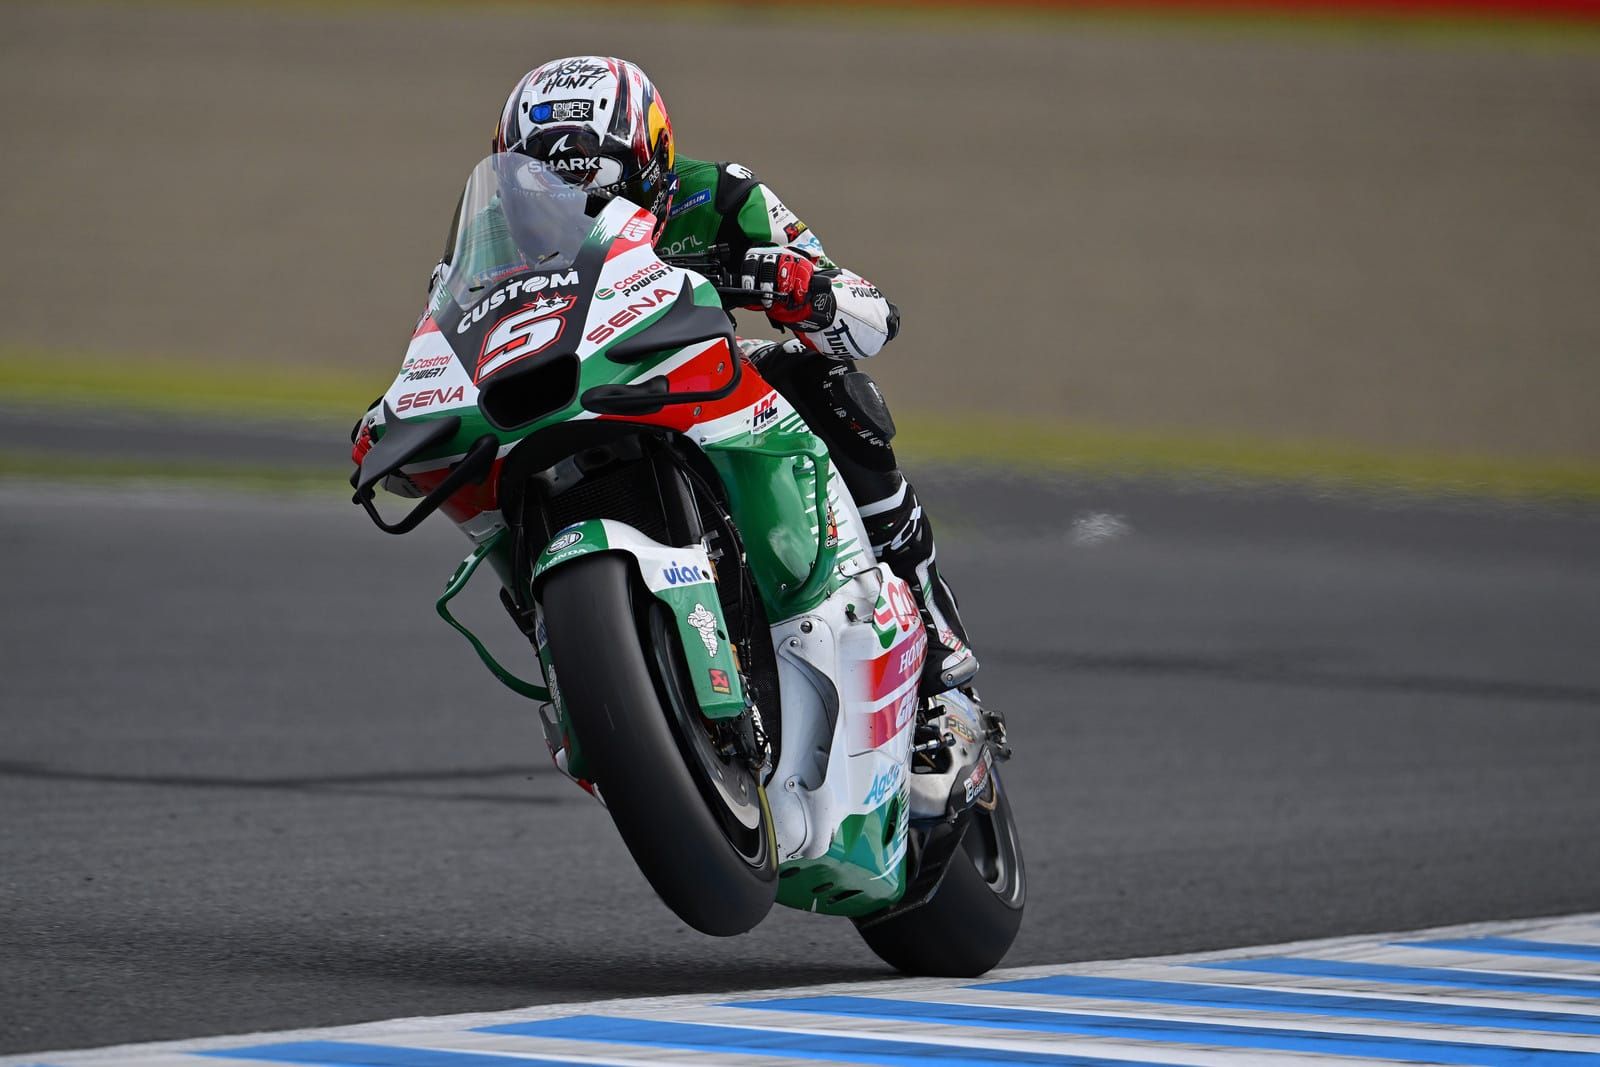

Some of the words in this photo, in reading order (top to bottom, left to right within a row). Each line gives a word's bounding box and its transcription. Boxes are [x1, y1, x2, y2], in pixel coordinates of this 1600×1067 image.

[527, 156, 600, 173] SHARK
[614, 261, 664, 291] Castrol
[456, 267, 580, 334] CUSTOM
[586, 288, 677, 345] SENA
[474, 293, 577, 386] 5
[412, 353, 454, 370] Castrol
[396, 385, 464, 412] SENA
[753, 392, 778, 428] HRC
[541, 548, 589, 572] HONDA
[662, 560, 702, 585] viar
